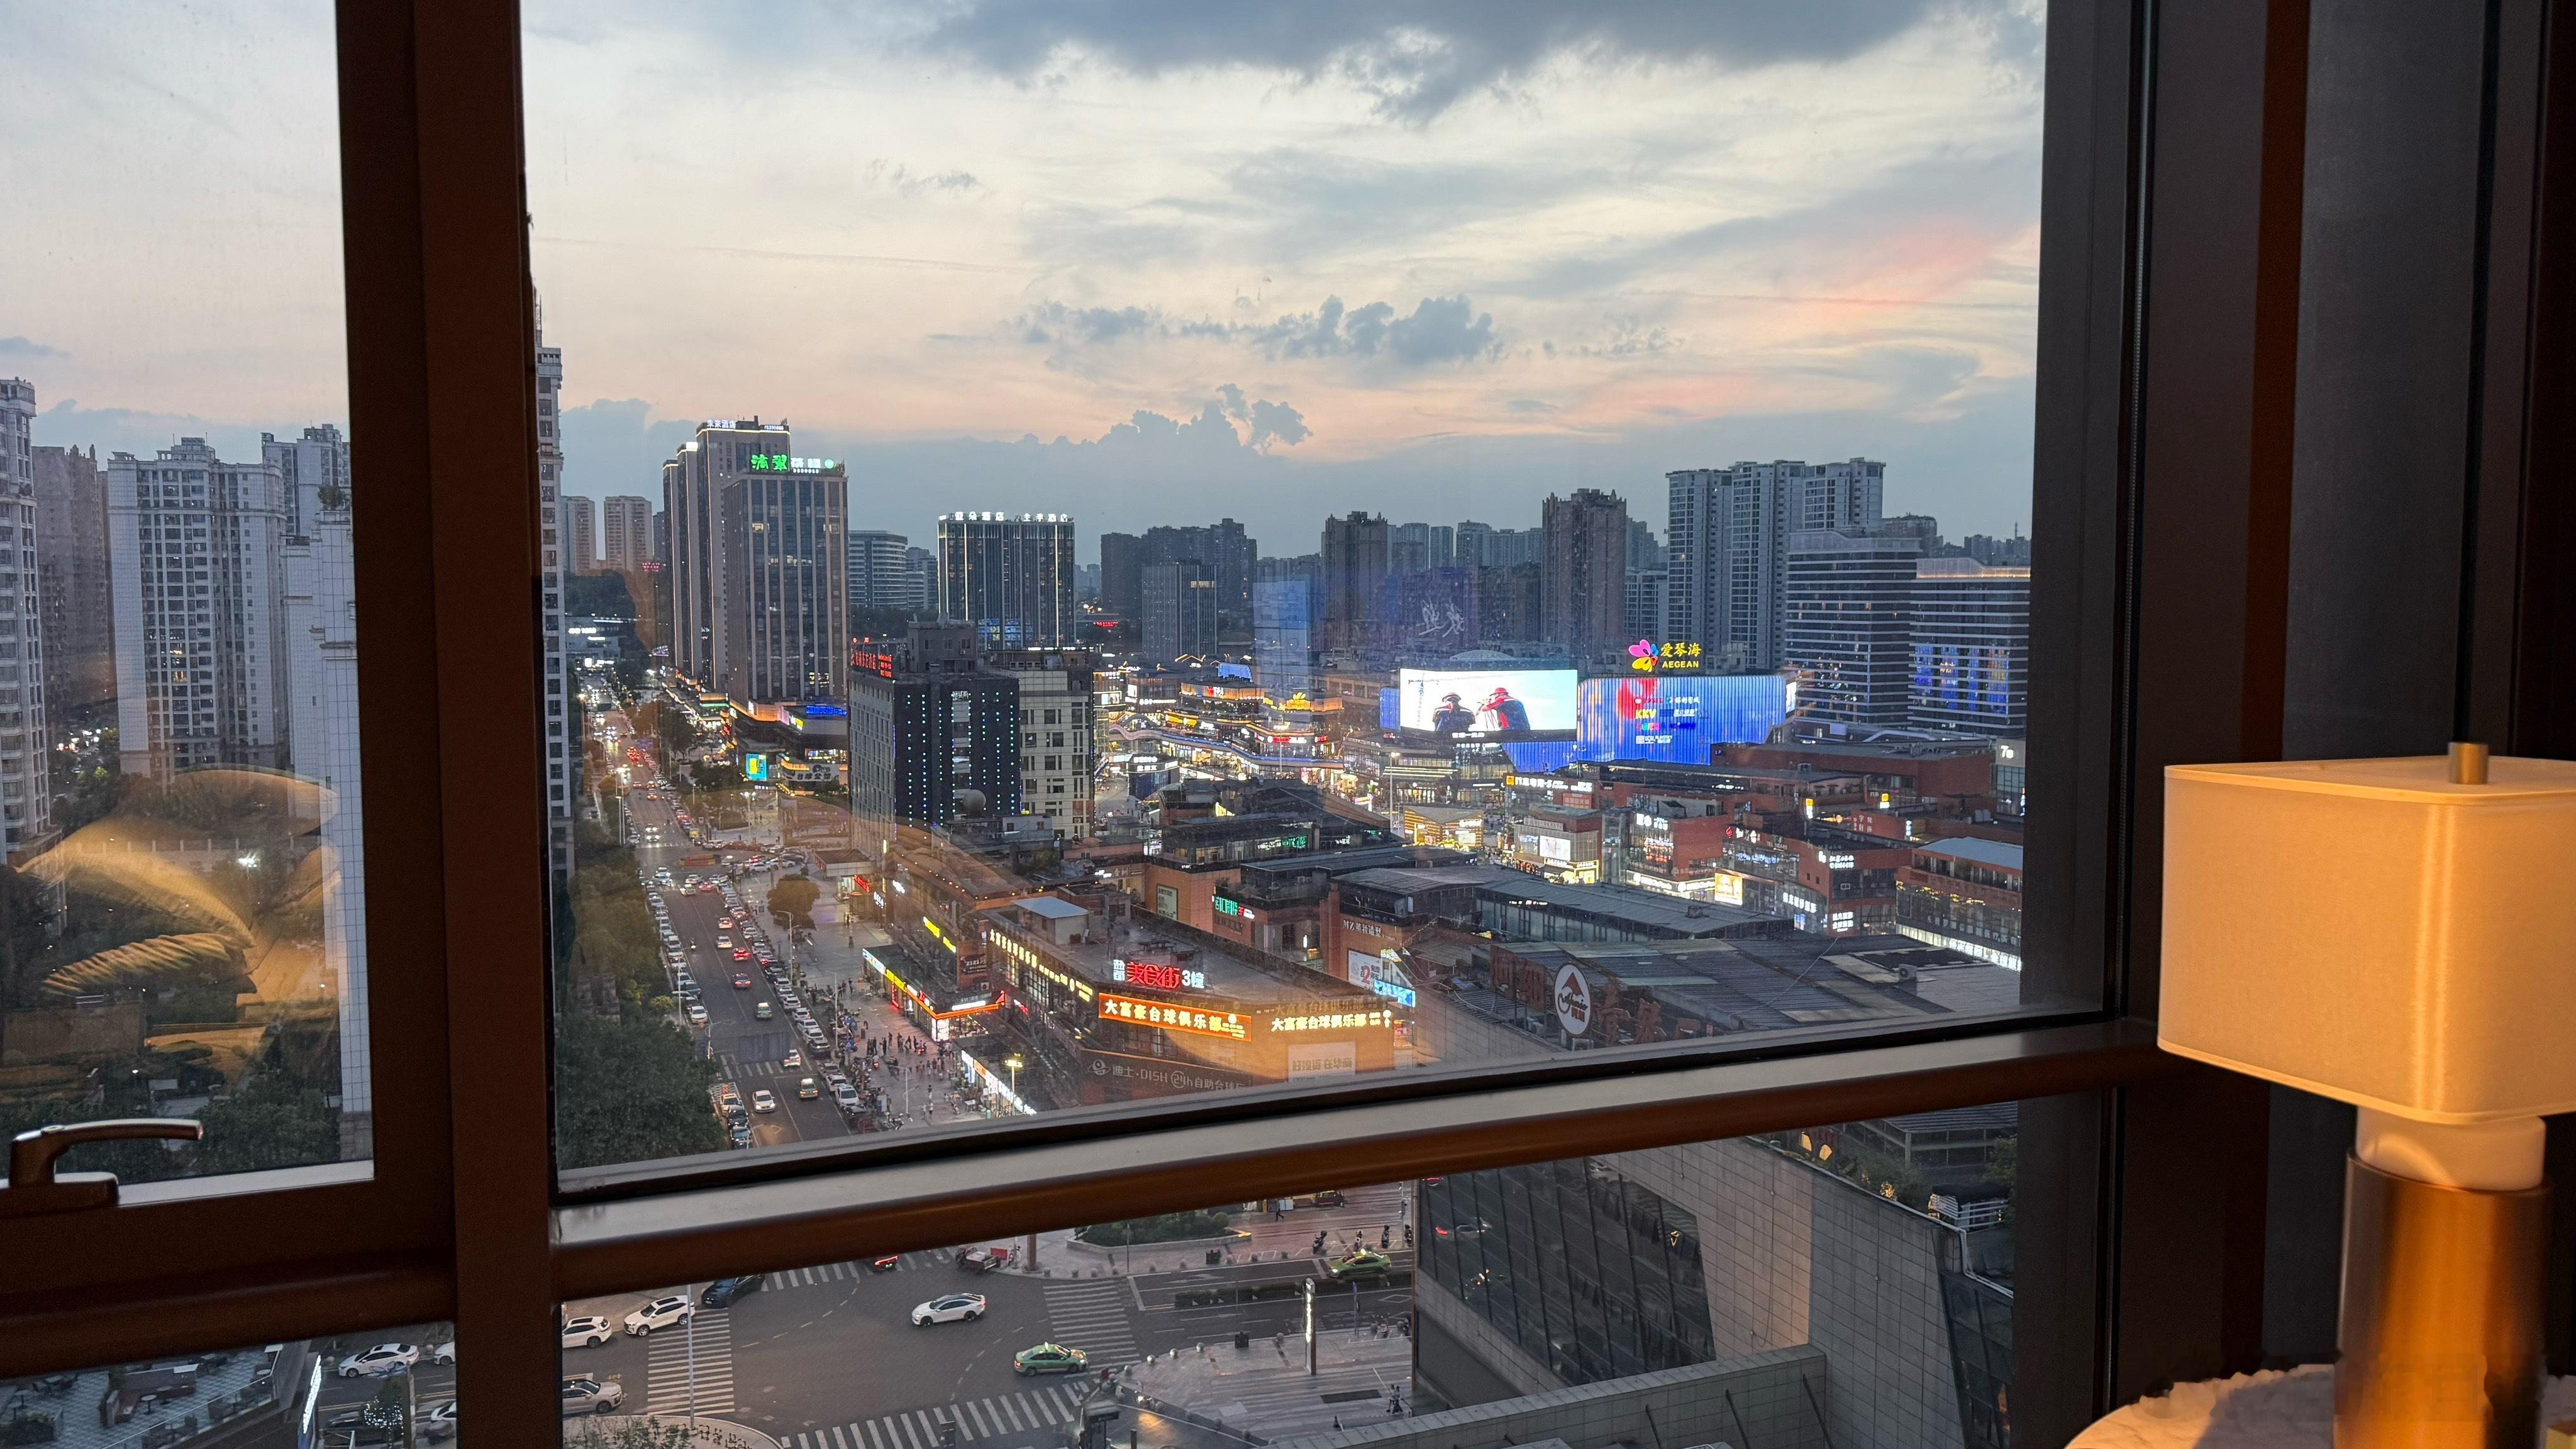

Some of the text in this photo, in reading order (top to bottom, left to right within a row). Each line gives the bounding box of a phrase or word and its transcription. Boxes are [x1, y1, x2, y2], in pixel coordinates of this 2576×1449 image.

[1660, 643, 1701, 658] 爱琴海
[1662, 660, 1699, 669] AEGEAN
[1635, 708, 1657, 719] KKV
[1126, 961, 1180, 989] 美食街
[1181, 969, 1204, 989] 3幢
[1104, 999, 1222, 1032] 大富豪台球俱乐部
[1271, 1013, 1367, 1031] 大富豪台球俱乐部
